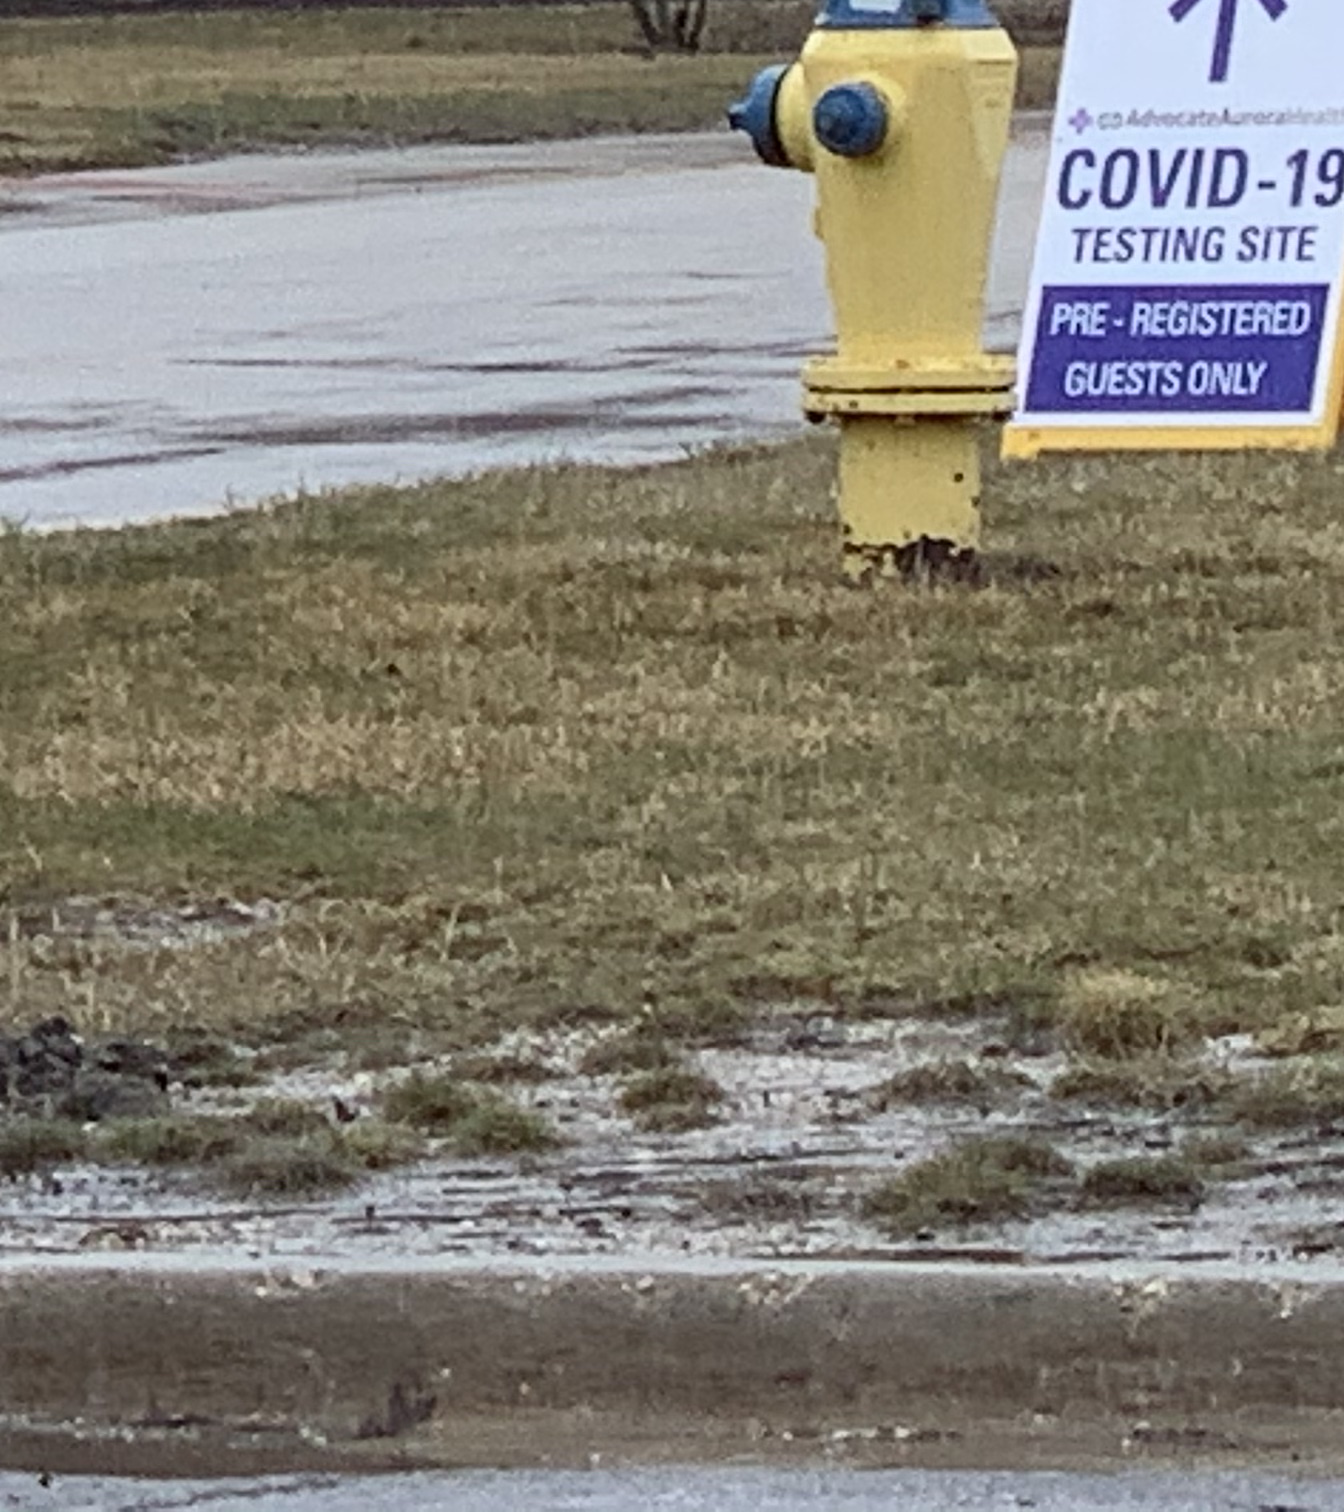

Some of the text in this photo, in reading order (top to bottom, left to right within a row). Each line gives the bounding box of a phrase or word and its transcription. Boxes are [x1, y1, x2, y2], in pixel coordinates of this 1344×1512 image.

[1071, 225, 1319, 263] TESTING SITE
[1130, 301, 1311, 337] REGISTERED
[1064, 361, 1268, 397] GUESTS ONLY
